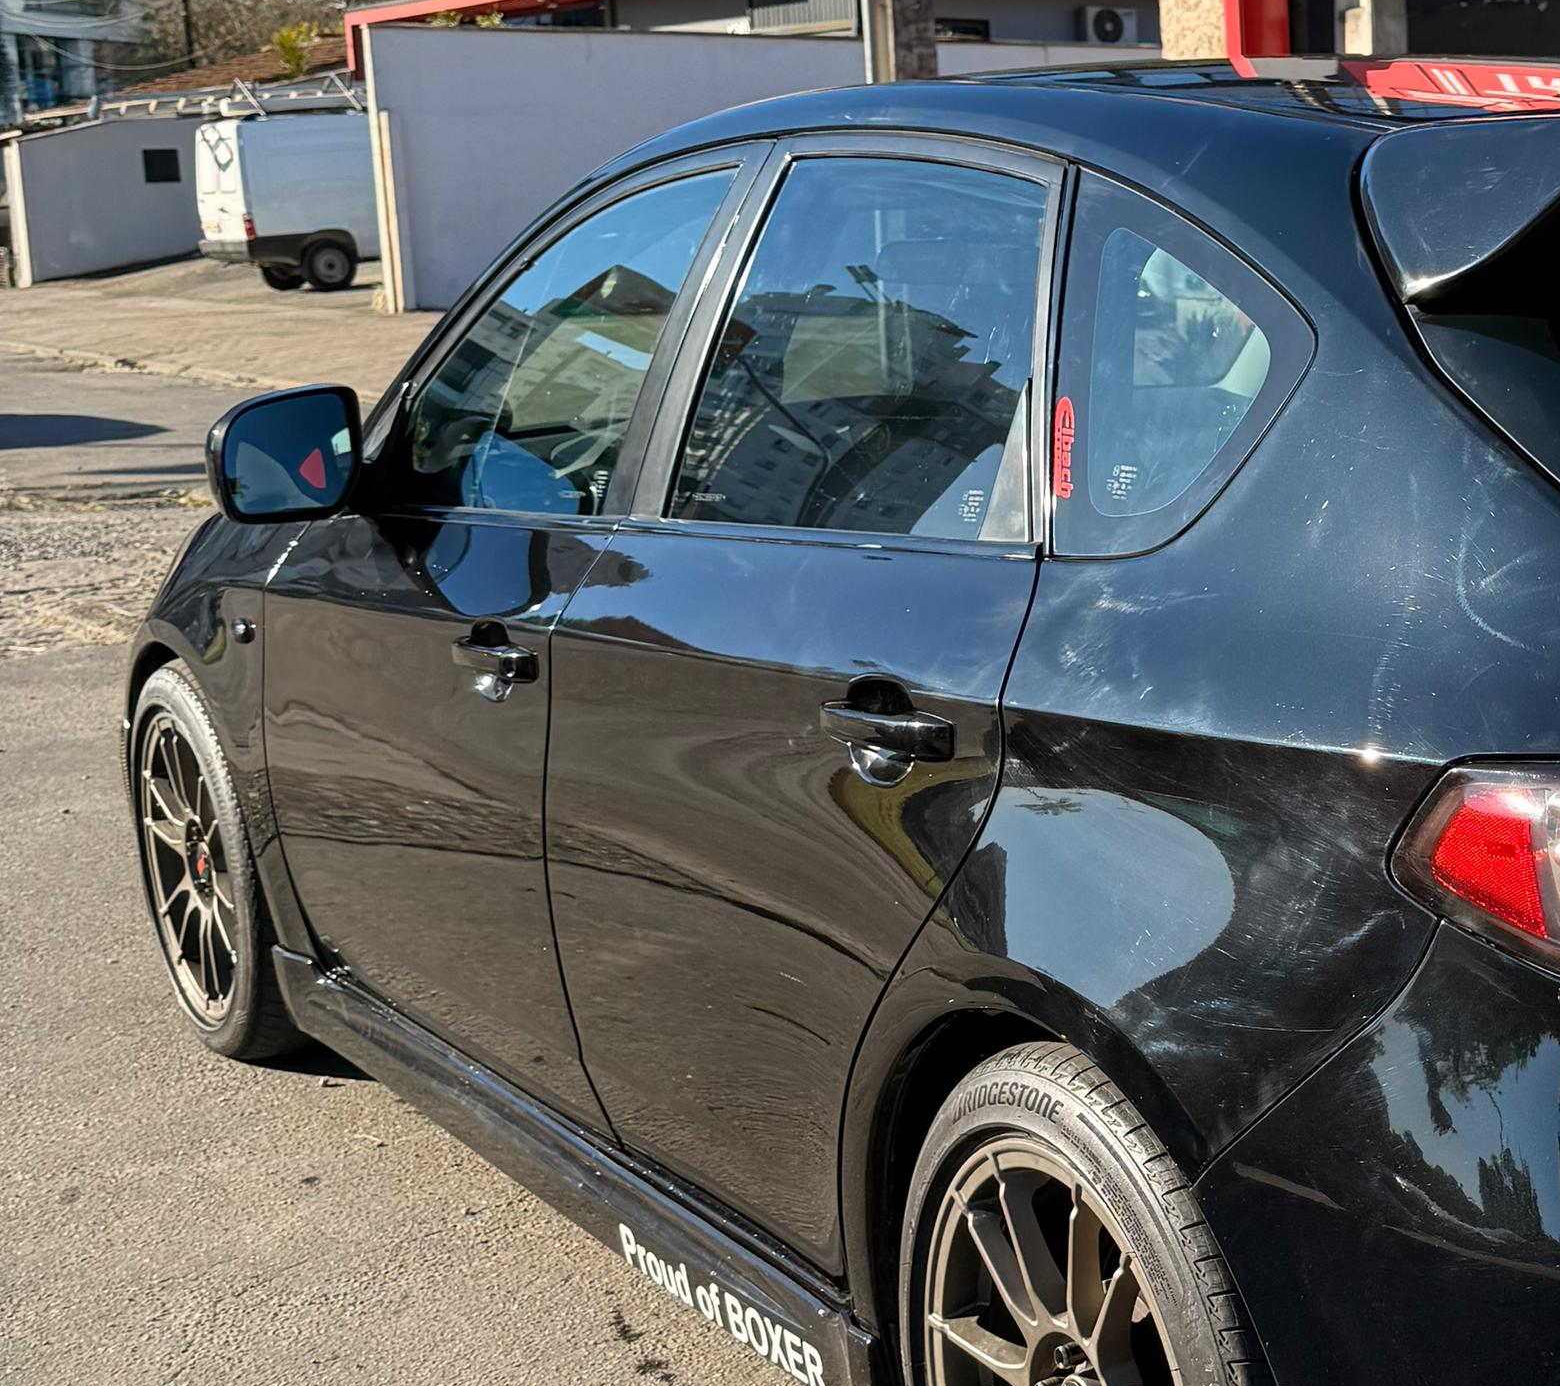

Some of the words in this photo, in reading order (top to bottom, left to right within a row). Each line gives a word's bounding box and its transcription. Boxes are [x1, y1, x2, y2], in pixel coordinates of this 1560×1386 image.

[951, 1081, 1065, 1126] BRIDGESTONE
[618, 1222, 695, 1308] Proud
[696, 1282, 724, 1328] of
